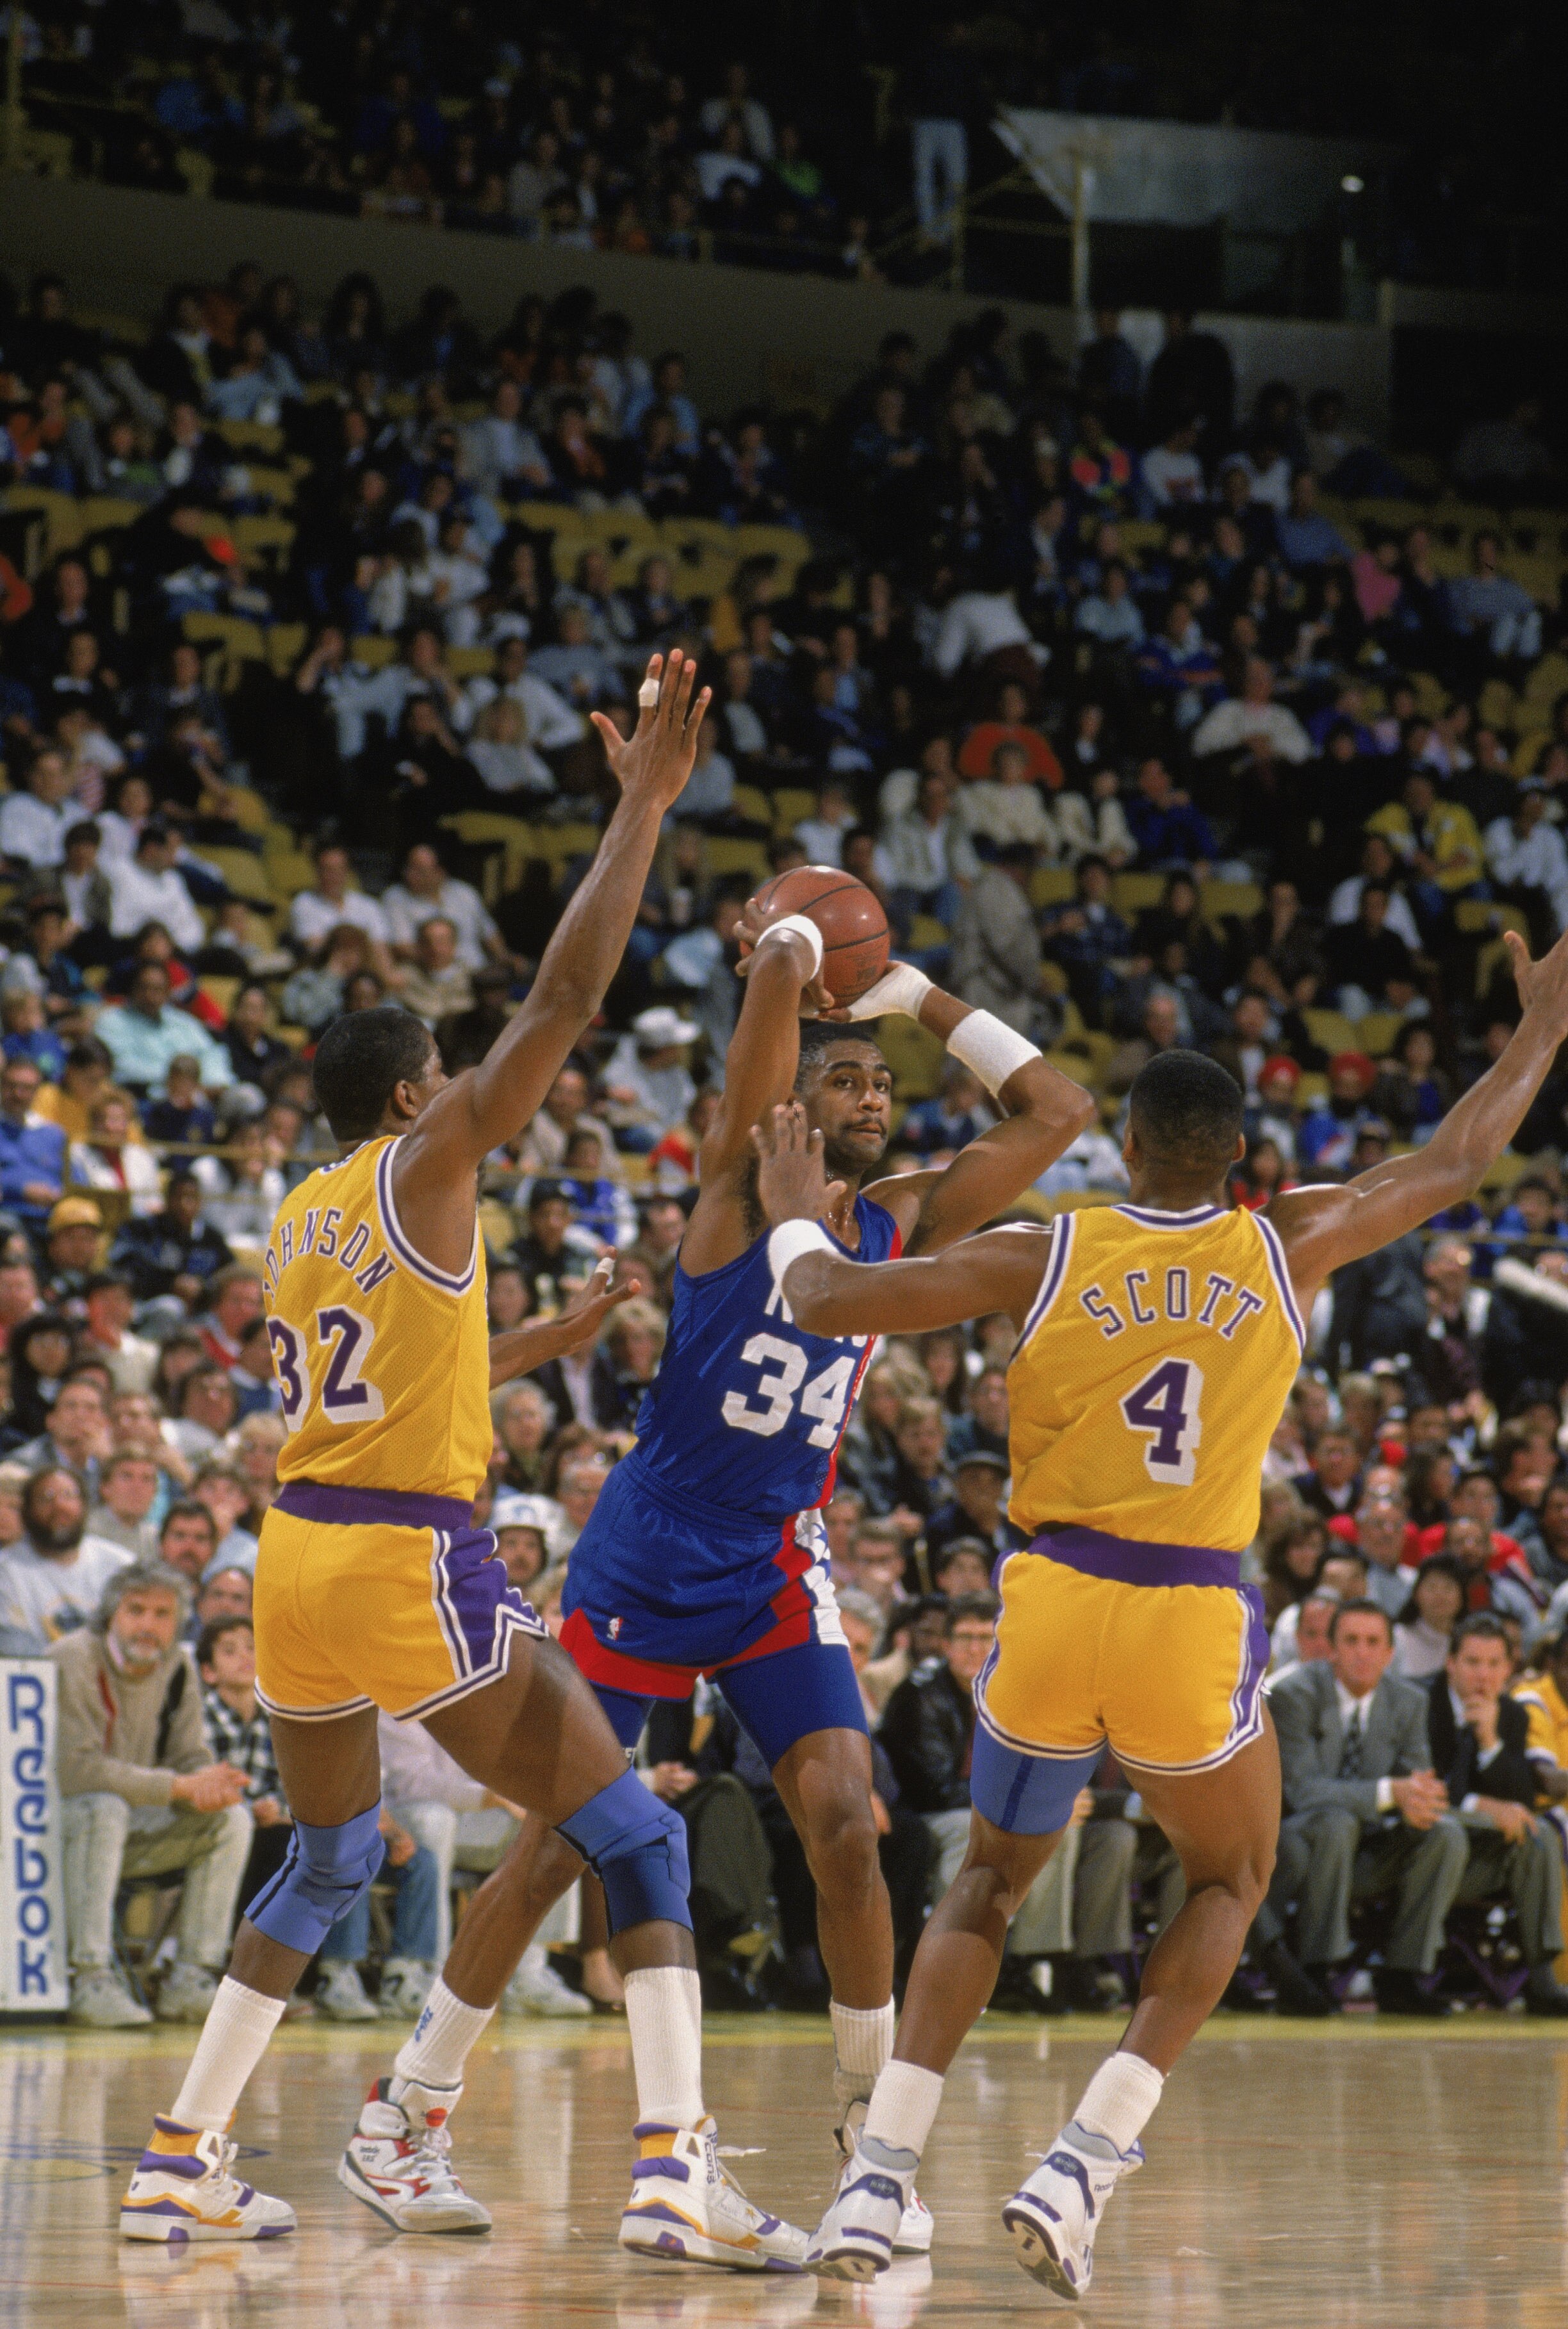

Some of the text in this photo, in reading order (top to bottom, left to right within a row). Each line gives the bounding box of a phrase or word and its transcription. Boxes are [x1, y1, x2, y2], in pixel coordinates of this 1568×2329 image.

[1079, 1266, 1266, 1341] SCOTT
[265, 1304, 386, 1433] 32
[721, 1332, 856, 1450] 34
[1120, 1356, 1204, 1487] 4
[8, 1673, 51, 1996] Reebok
